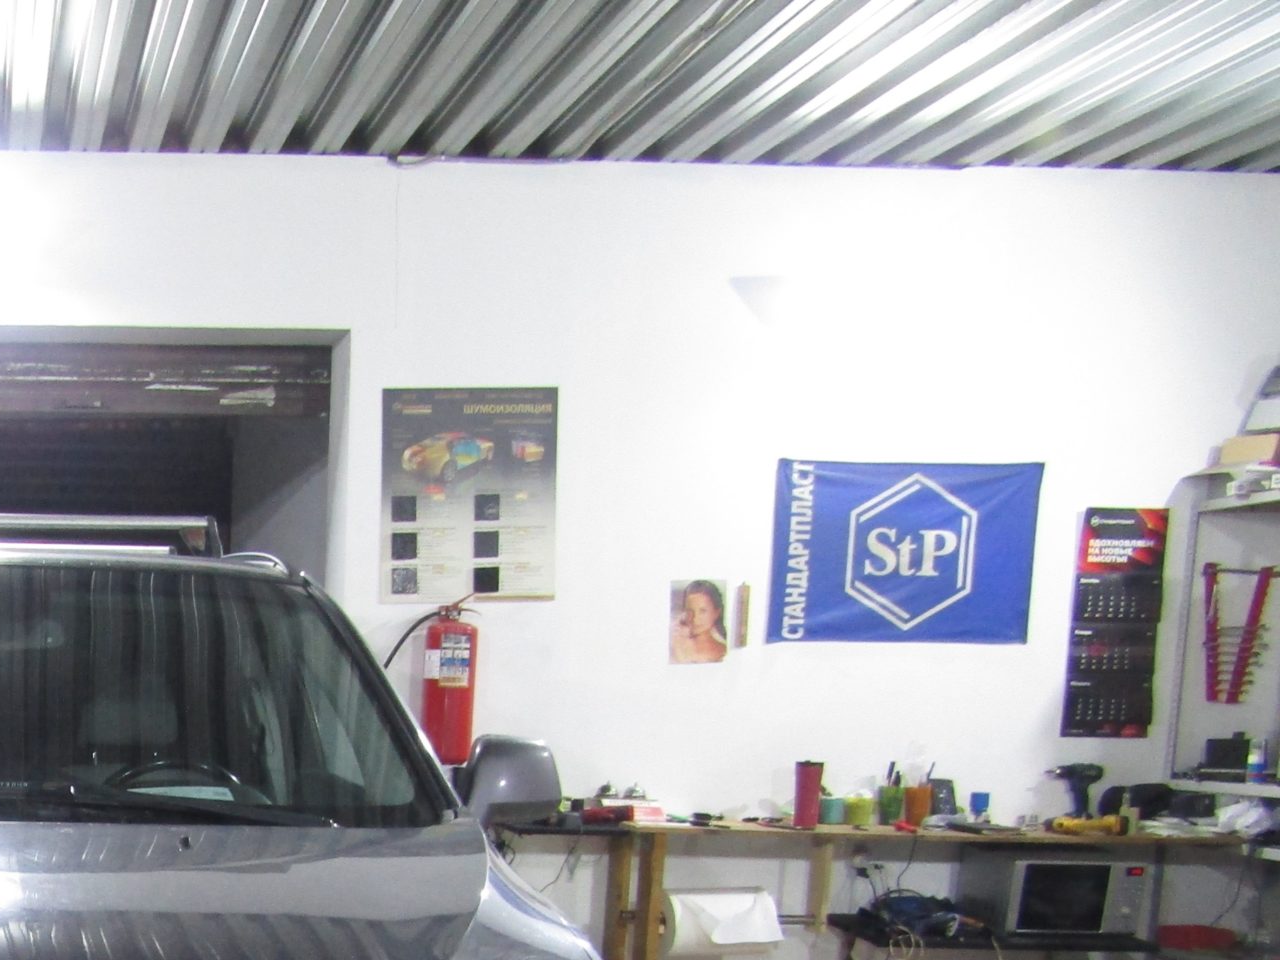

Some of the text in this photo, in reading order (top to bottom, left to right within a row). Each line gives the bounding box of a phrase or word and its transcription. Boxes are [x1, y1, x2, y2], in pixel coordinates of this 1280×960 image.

[463, 403, 553, 414] ШУМОИЗОЛЯЦИЯ
[781, 461, 816, 641] СТАНДАРТПЛАСТ
[864, 527, 957, 577] StP
[1087, 547, 1100, 555] НА
